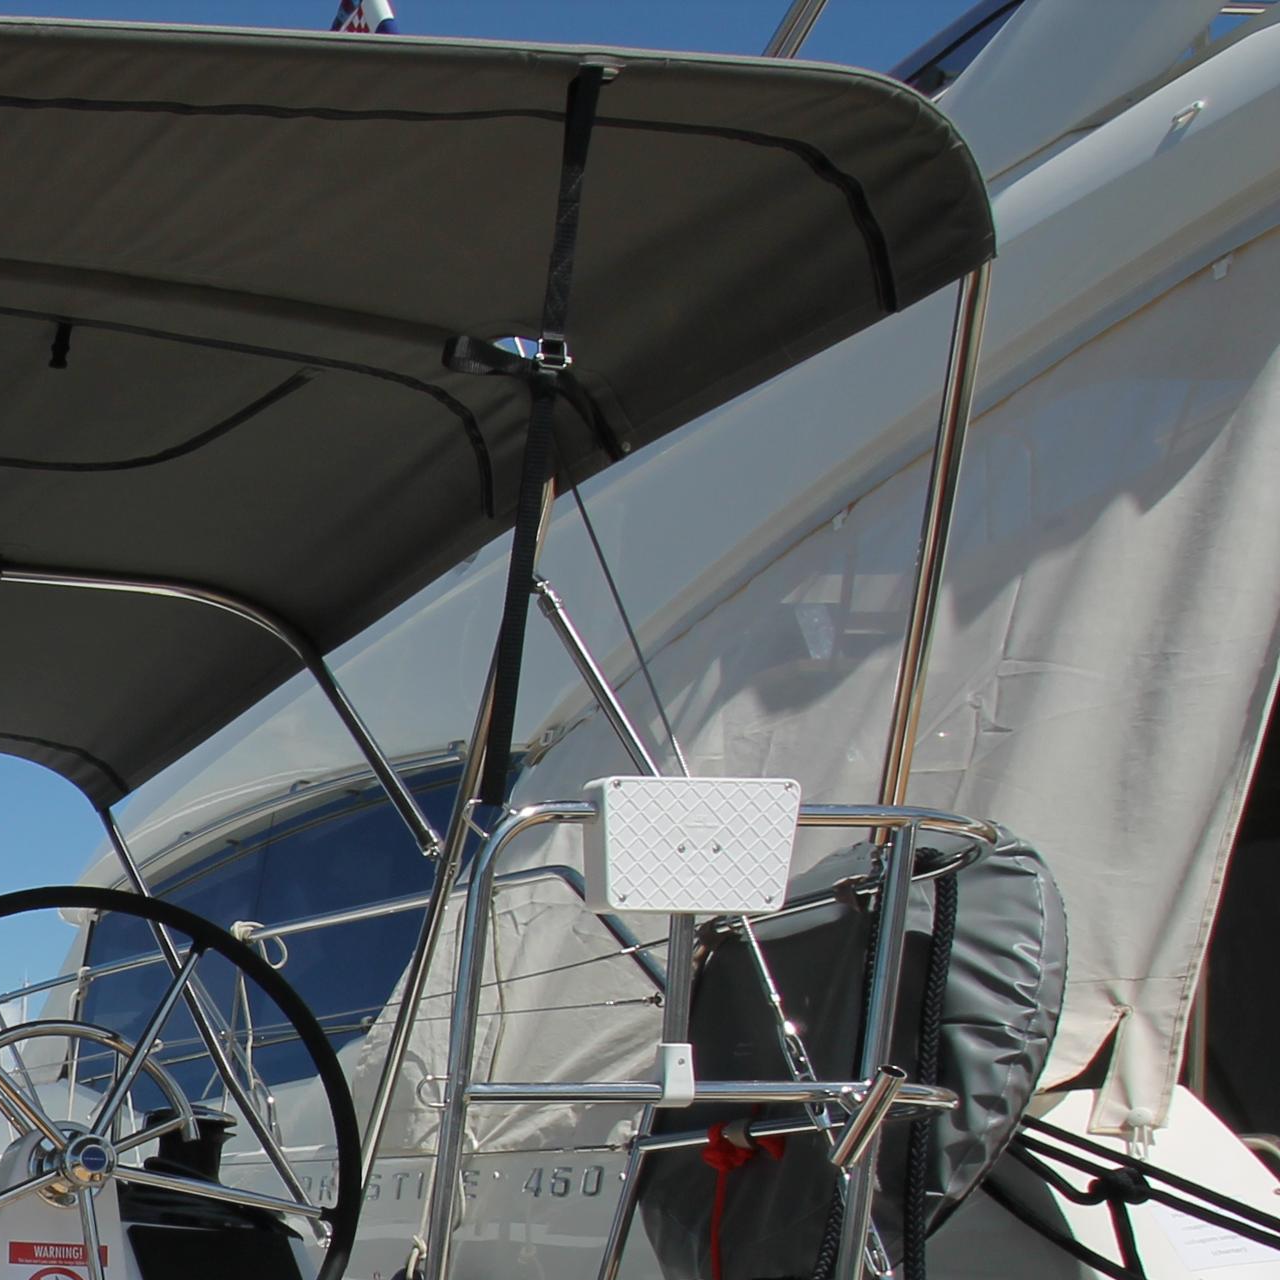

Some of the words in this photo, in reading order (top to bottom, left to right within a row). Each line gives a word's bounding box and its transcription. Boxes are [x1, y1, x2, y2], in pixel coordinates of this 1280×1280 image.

[302, 1169, 481, 1201] RSTIE
[521, 1164, 605, 1198] 460
[33, 1244, 84, 1260] WARNING!
